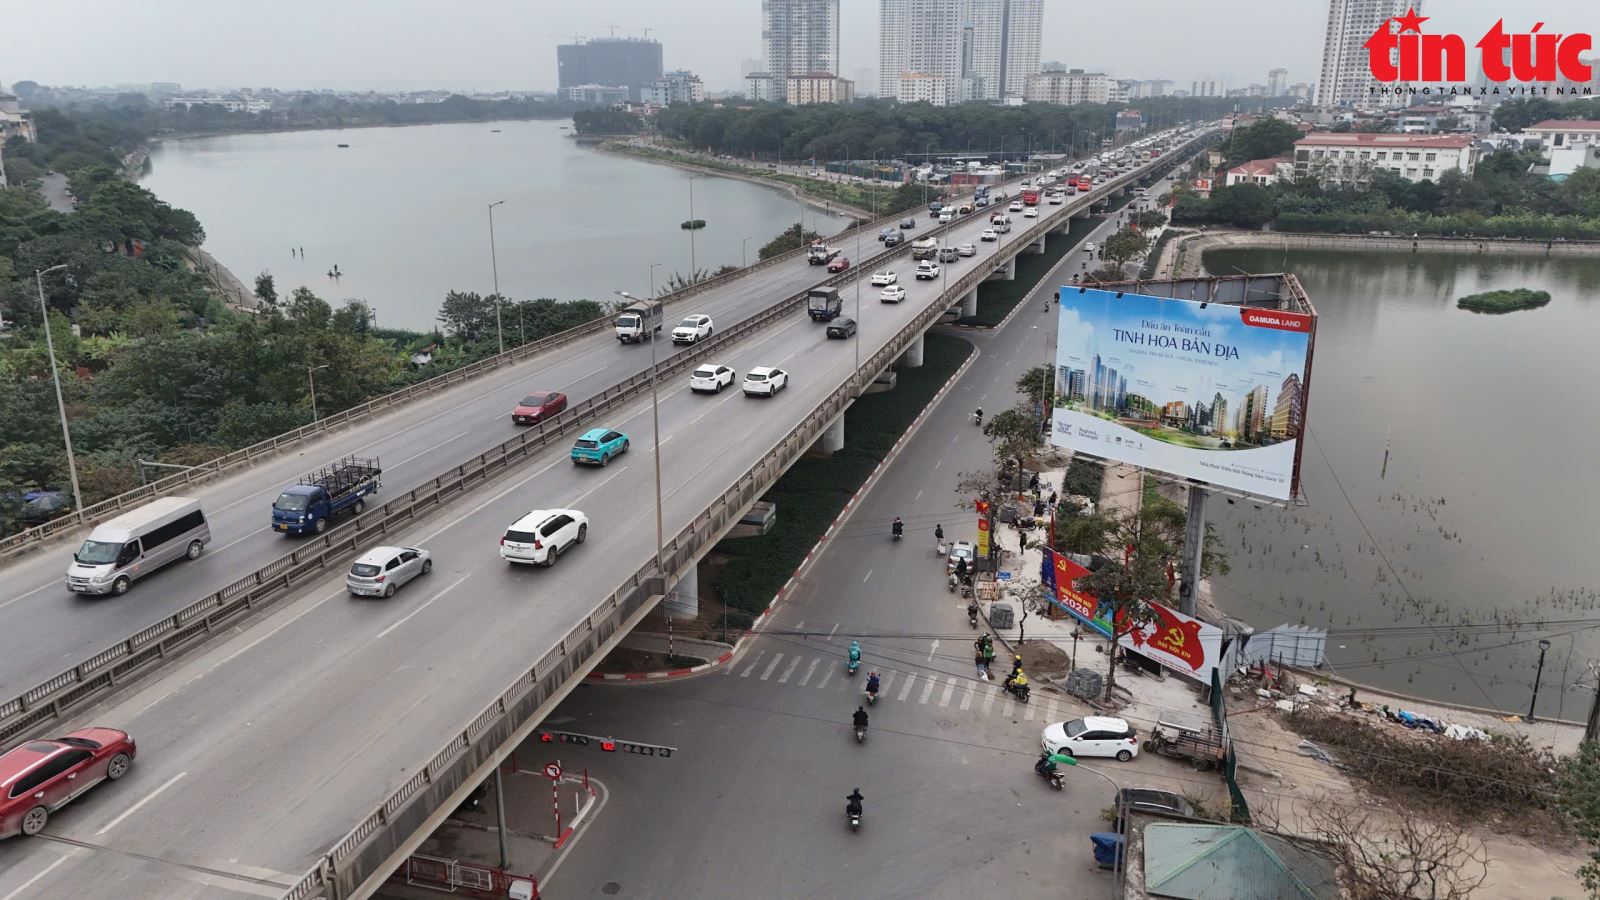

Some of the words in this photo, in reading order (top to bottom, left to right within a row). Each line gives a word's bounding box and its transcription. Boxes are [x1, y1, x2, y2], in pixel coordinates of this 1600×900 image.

[1249, 315, 1280, 325] GAMUDA
[1281, 319, 1301, 328] LAND
[1113, 328, 1144, 345] TINH
[1148, 334, 1178, 350] HOA
[1181, 337, 1211, 355] BẢN
[1215, 344, 1240, 361] ĐỊA
[1062, 594, 1090, 617] 2026
